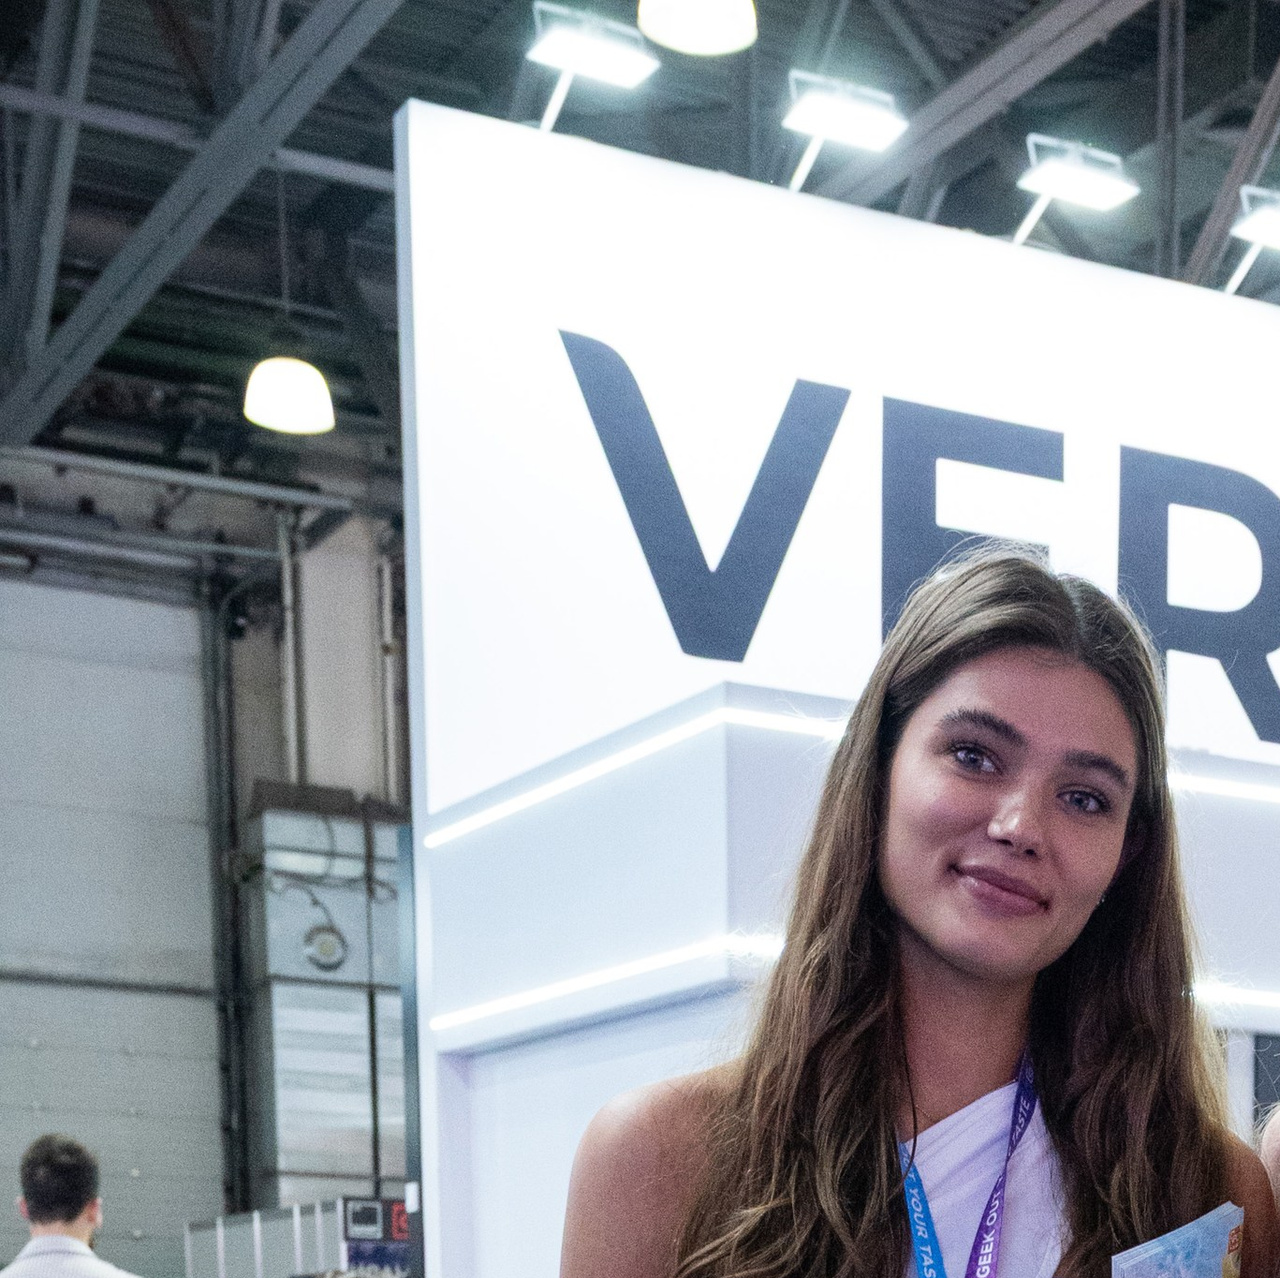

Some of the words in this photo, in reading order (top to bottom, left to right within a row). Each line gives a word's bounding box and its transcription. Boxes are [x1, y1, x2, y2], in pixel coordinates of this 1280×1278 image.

[909, 1188, 928, 1239] YOUR
[976, 1229, 996, 1278] GEEK
[986, 1190, 1001, 1226] OUT
